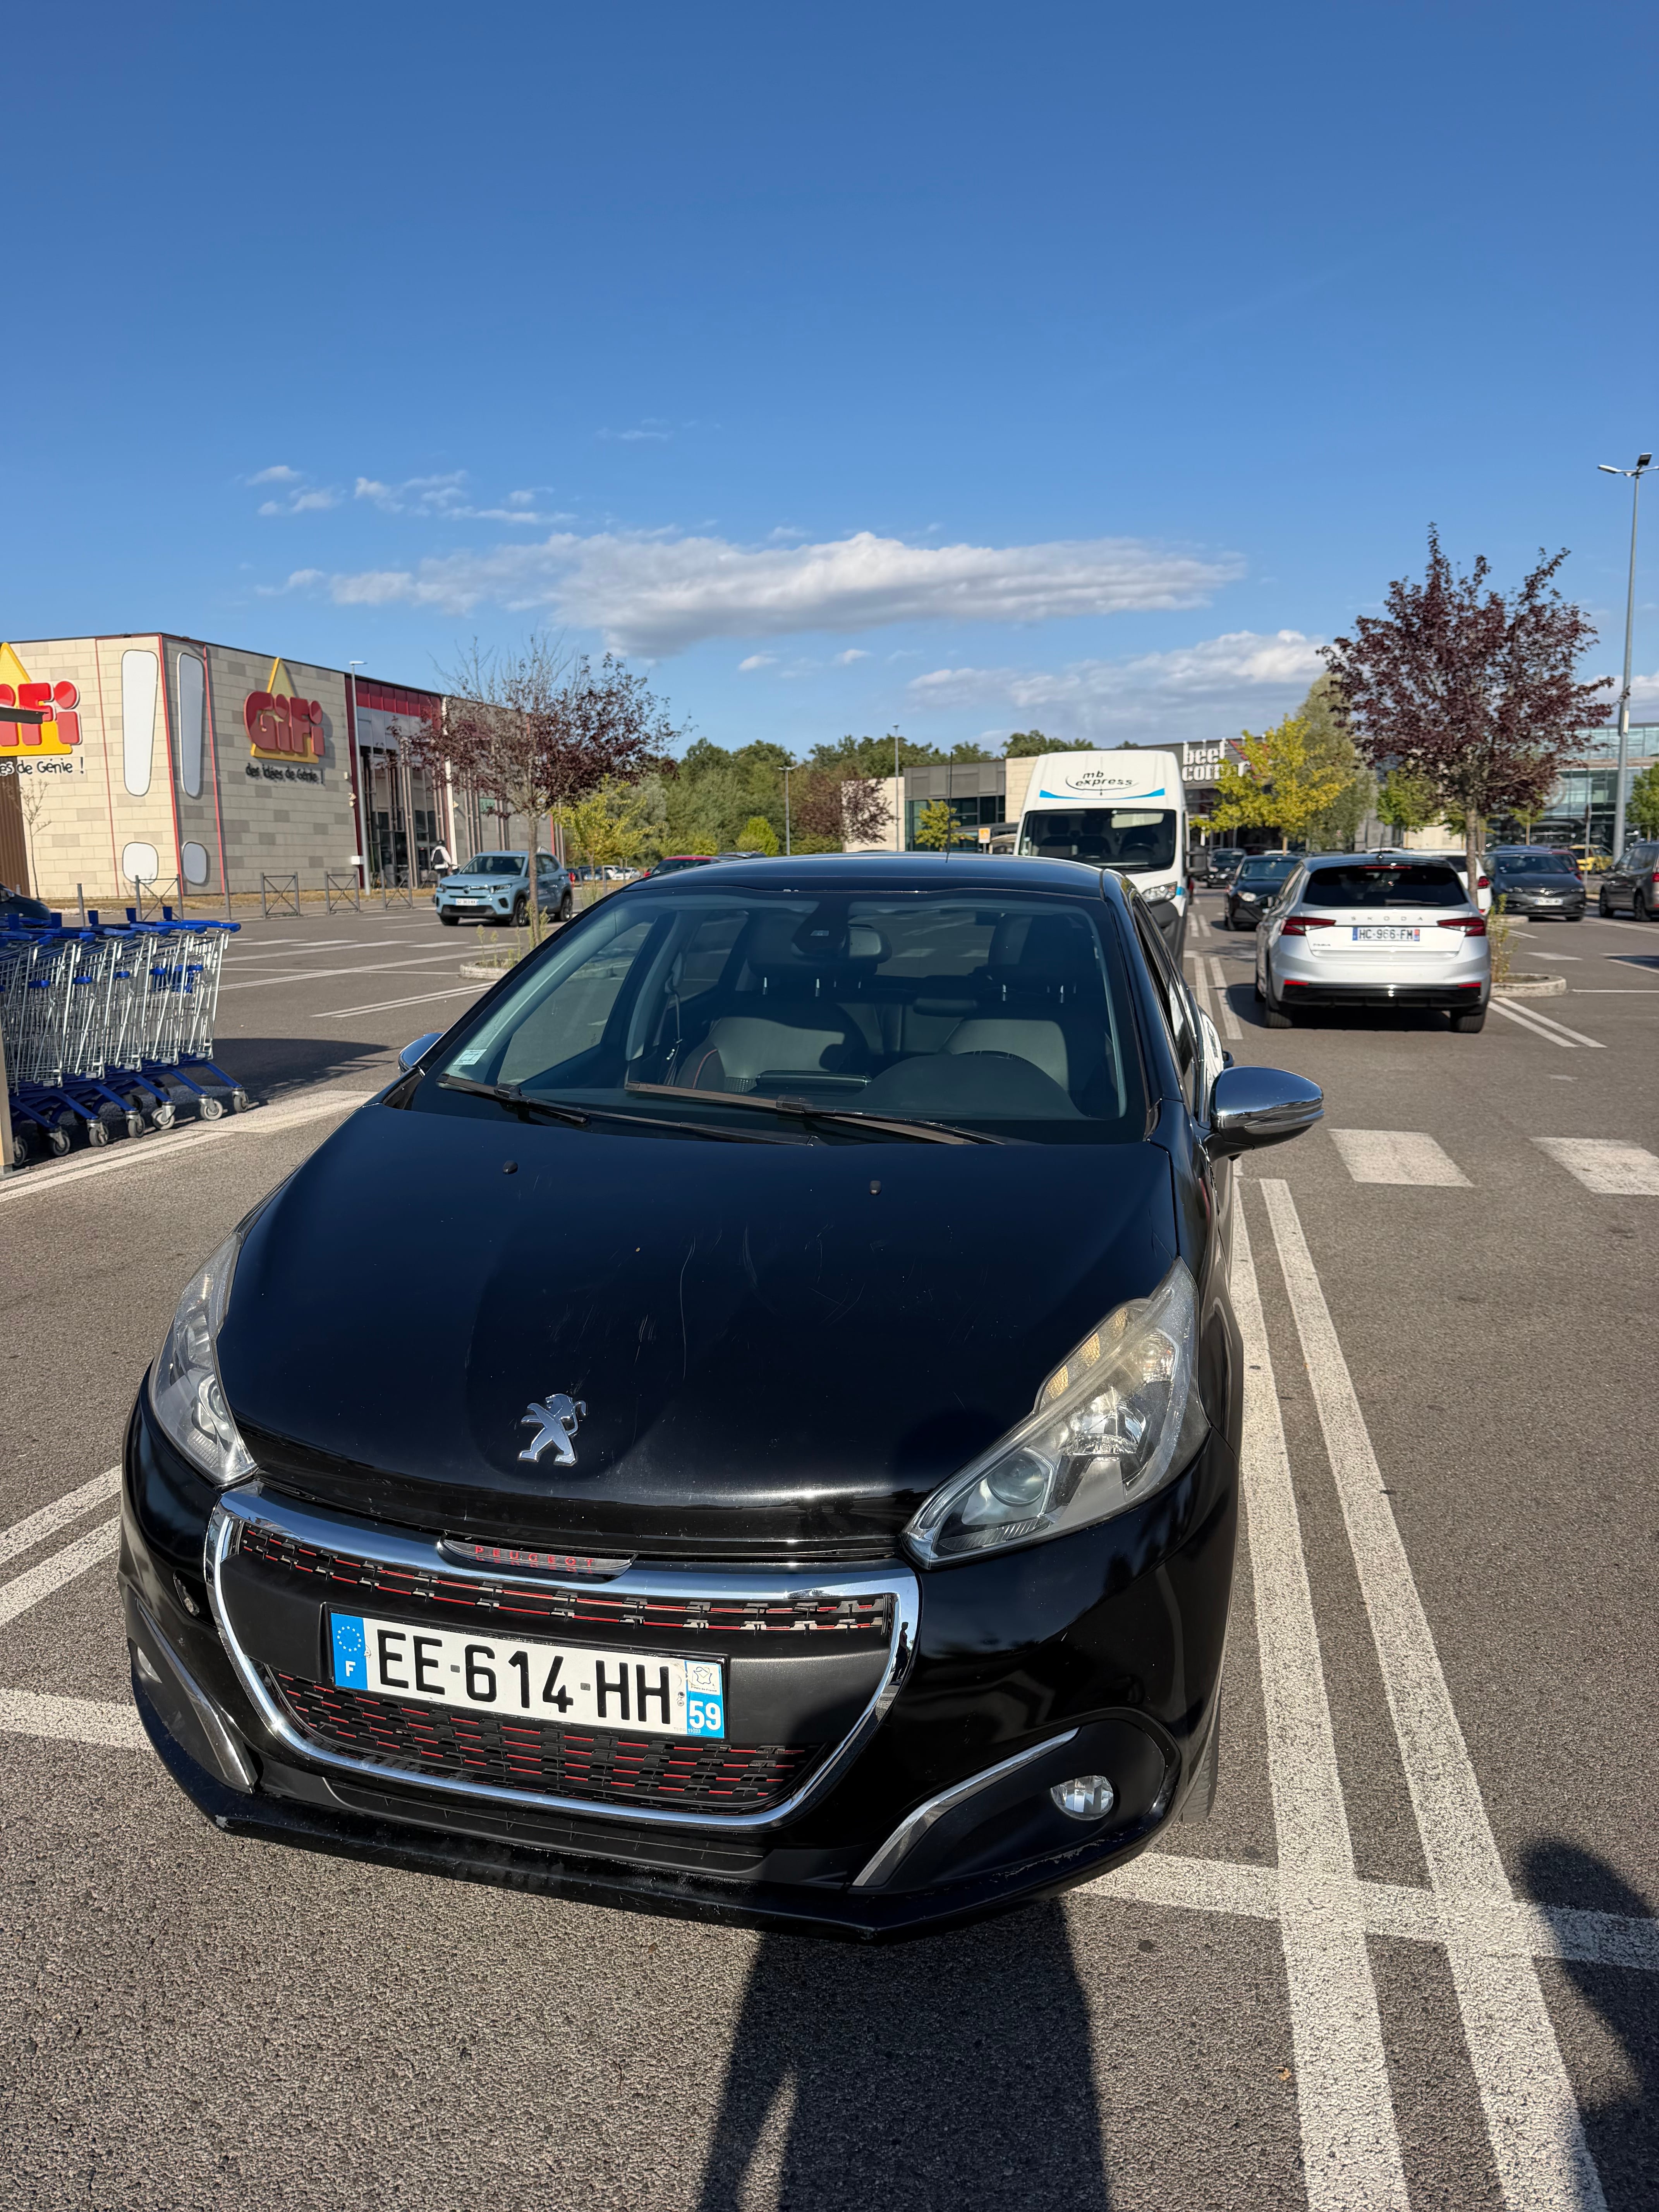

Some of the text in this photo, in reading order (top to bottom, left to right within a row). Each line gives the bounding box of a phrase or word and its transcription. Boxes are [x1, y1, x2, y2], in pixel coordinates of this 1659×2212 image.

[244, 691, 325, 756] GiFi
[1183, 740, 1228, 766] beef
[17, 760, 33, 775] de
[37, 758, 73, 774] Génie
[80, 757, 84, 774] !
[246, 762, 260, 776] des
[285, 766, 295, 780] de
[1083, 771, 1104, 779] mb
[1182, 761, 1251, 781] cornr
[1075, 779, 1133, 787] express
[475, 1546, 594, 1567] PEUGEOT
[345, 1661, 356, 1677] F
[377, 1629, 670, 1724] EE-614-HH
[689, 1700, 721, 1731] 59
